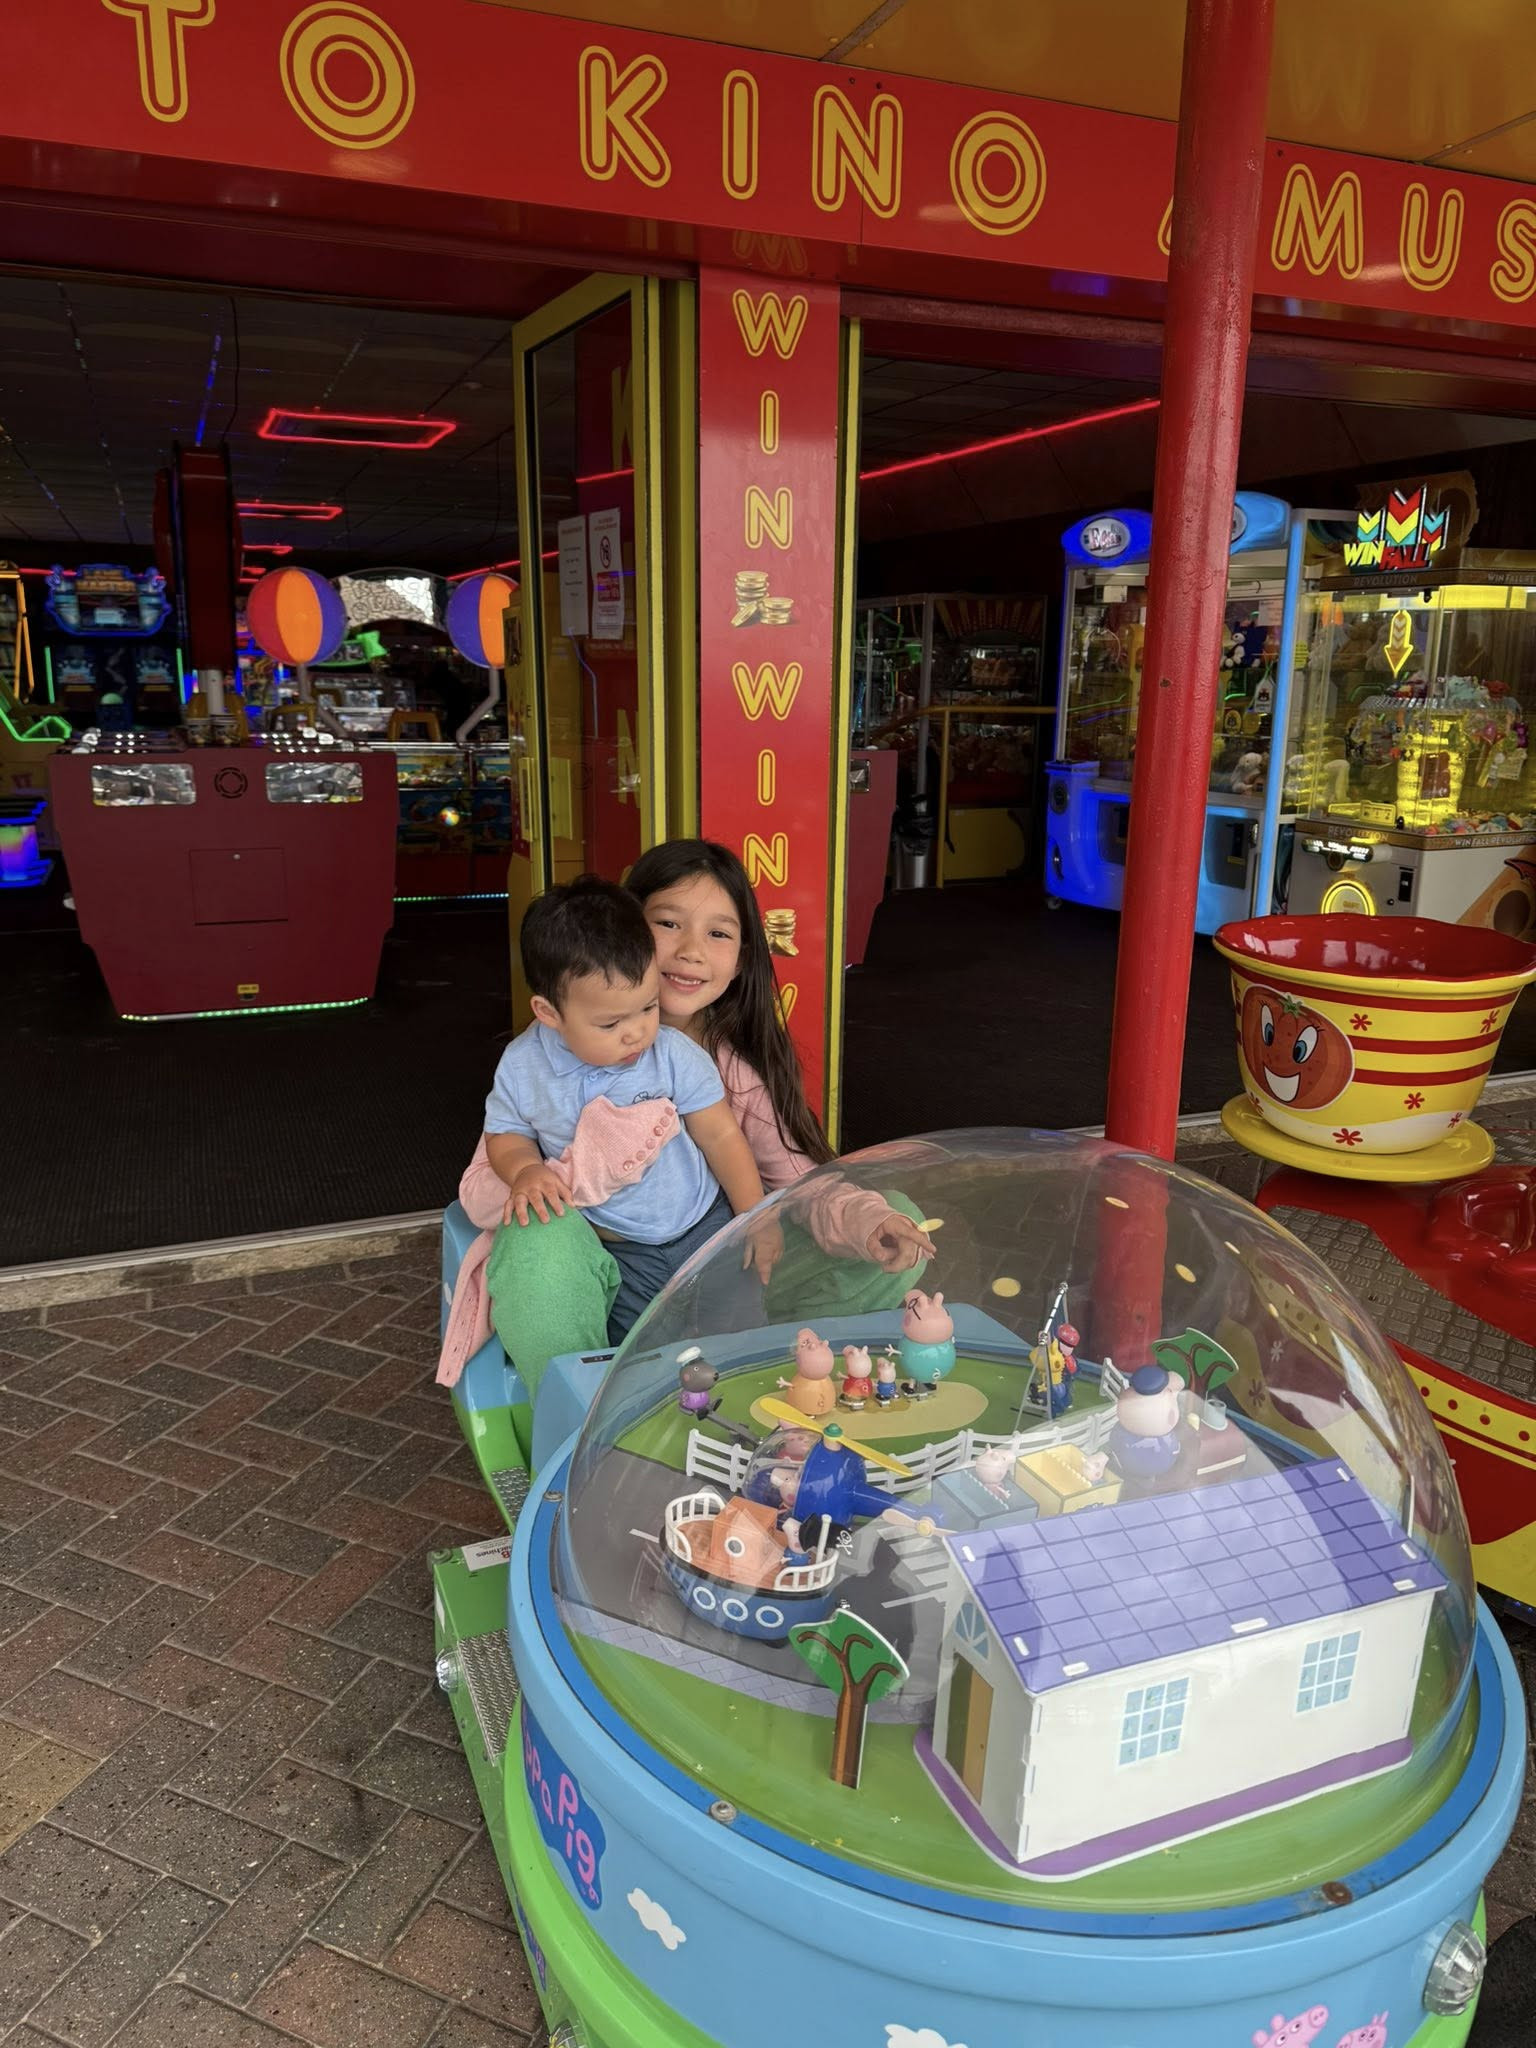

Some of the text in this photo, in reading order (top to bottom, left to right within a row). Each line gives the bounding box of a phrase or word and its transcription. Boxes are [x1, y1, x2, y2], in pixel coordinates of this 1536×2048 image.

[103, 0, 1536, 303] TO KINO MUS
[732, 289, 809, 550] WIN
[1353, 574, 1419, 586] REVOLUTION
[732, 661, 803, 888] WIN
[557, 1772, 596, 1887] Pig
